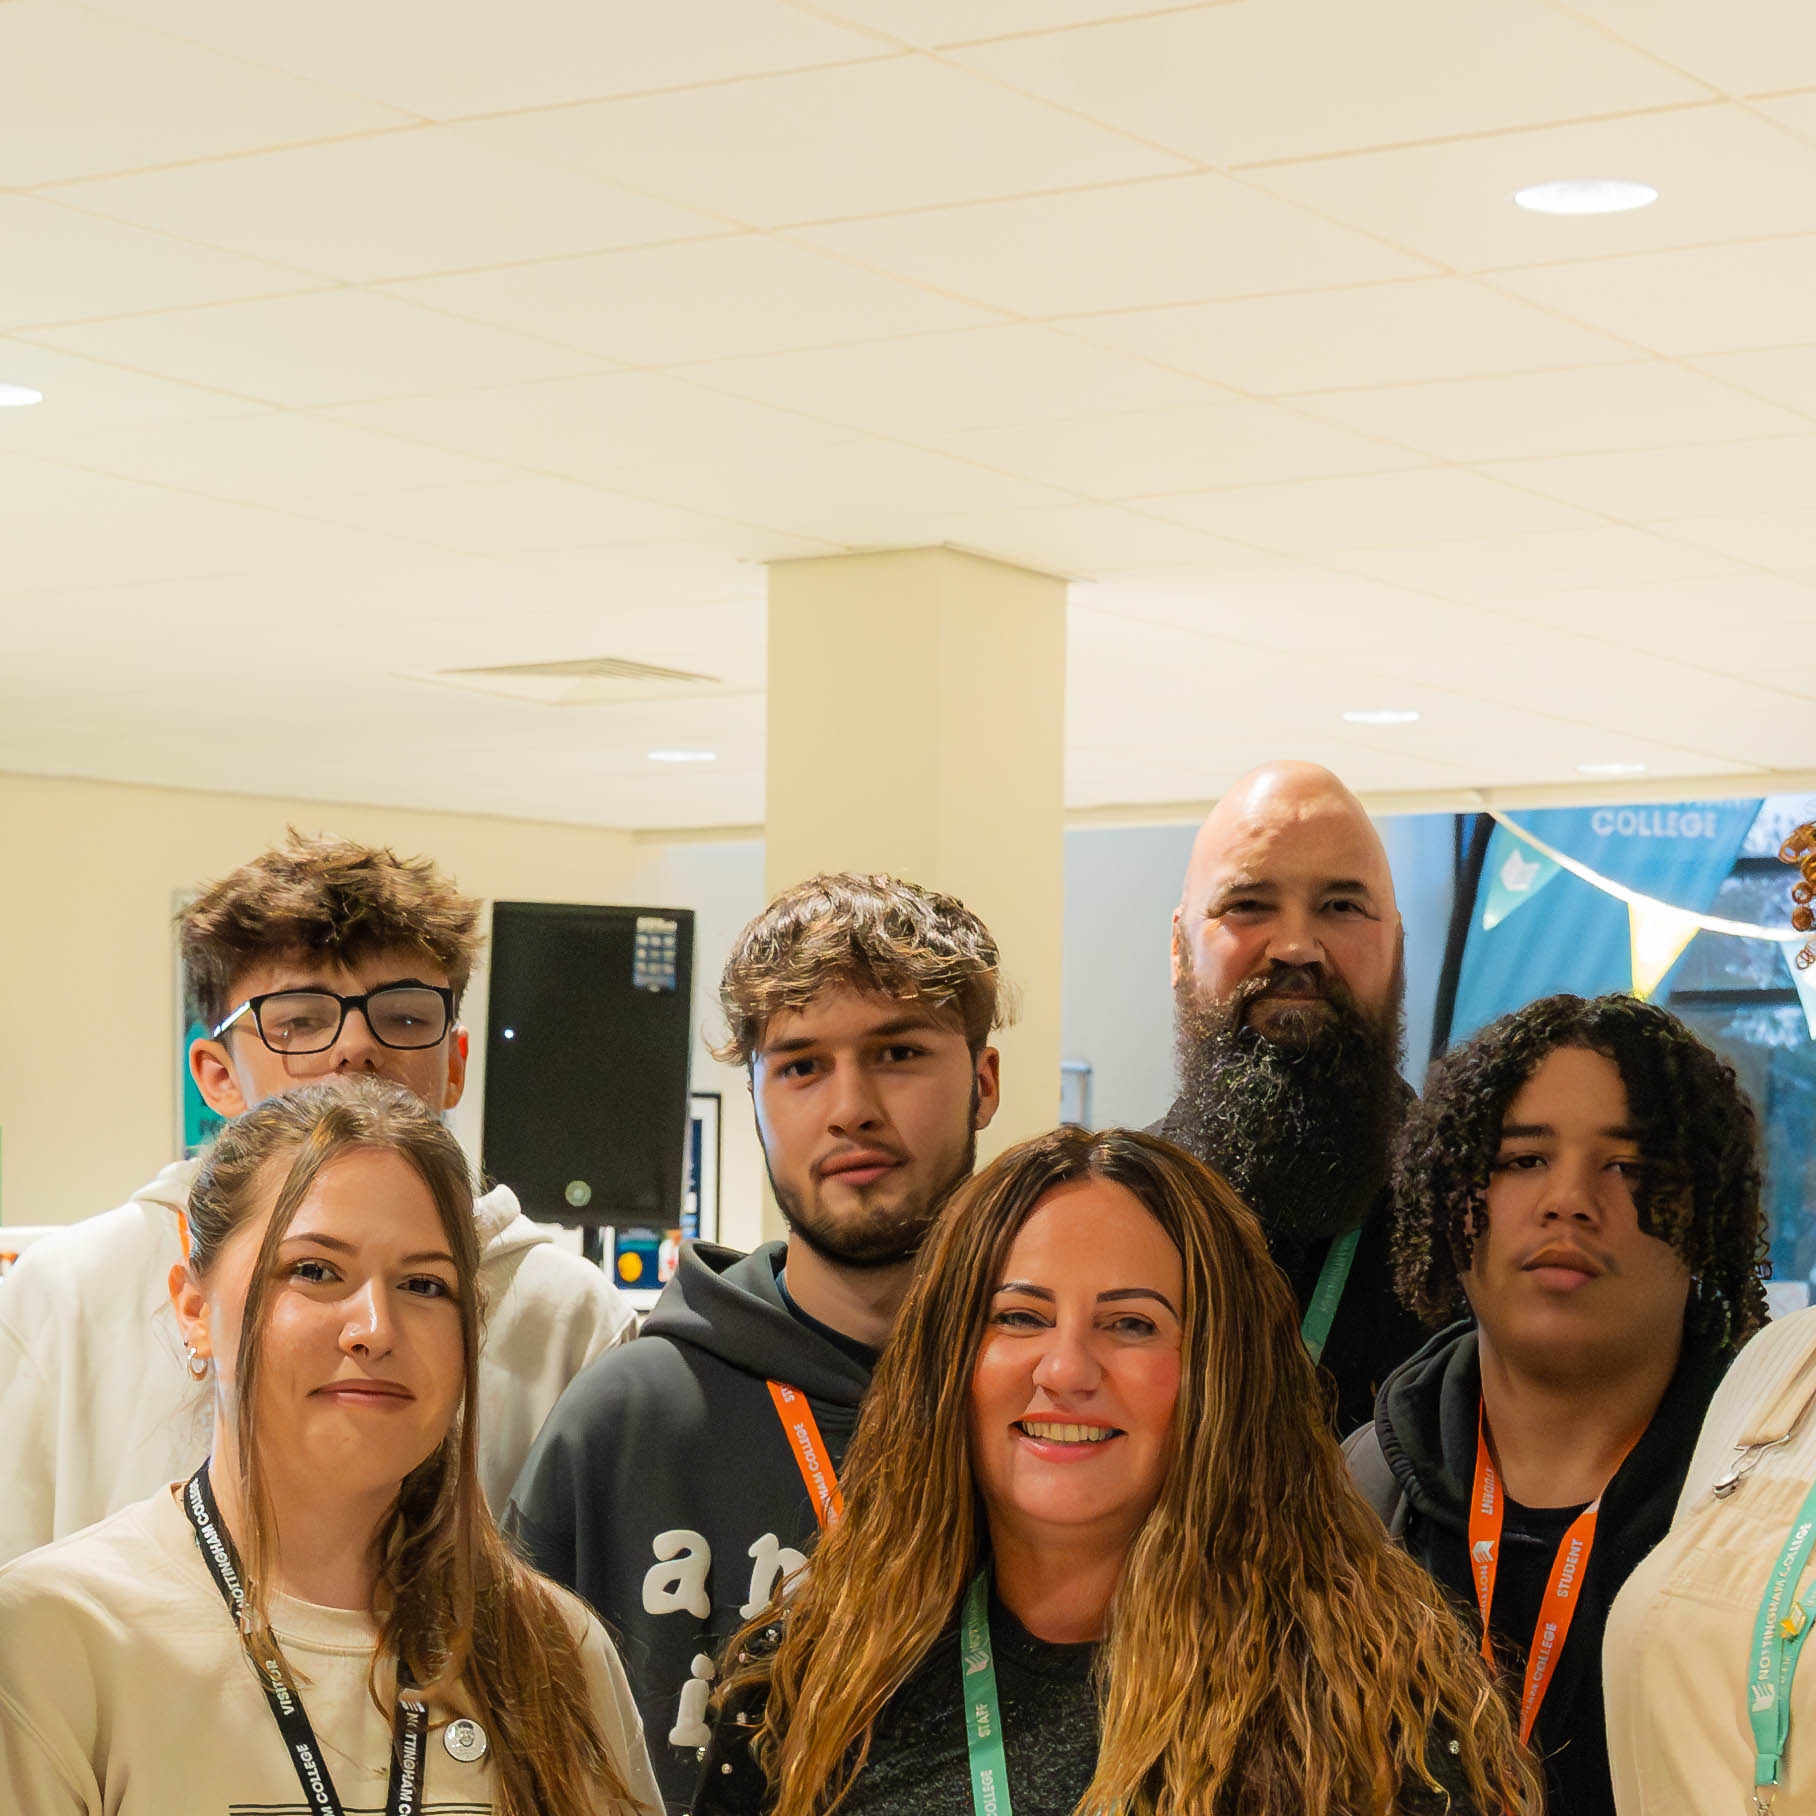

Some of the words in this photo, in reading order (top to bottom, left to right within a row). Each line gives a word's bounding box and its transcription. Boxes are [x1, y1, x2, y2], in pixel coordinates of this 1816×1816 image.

[1591, 810, 1717, 838] COLLEGE
[201, 1522, 250, 1609] NOTTINGHAM
[1557, 1538, 1584, 1599] STUDENT
[1532, 1622, 1558, 1682] COLLEGE
[1758, 1572, 1786, 1681] NOTTINGHAM
[266, 1658, 295, 1716] VISITOR
[975, 1704, 992, 1737] STAFF
[295, 1743, 328, 1804] COLLEGE
